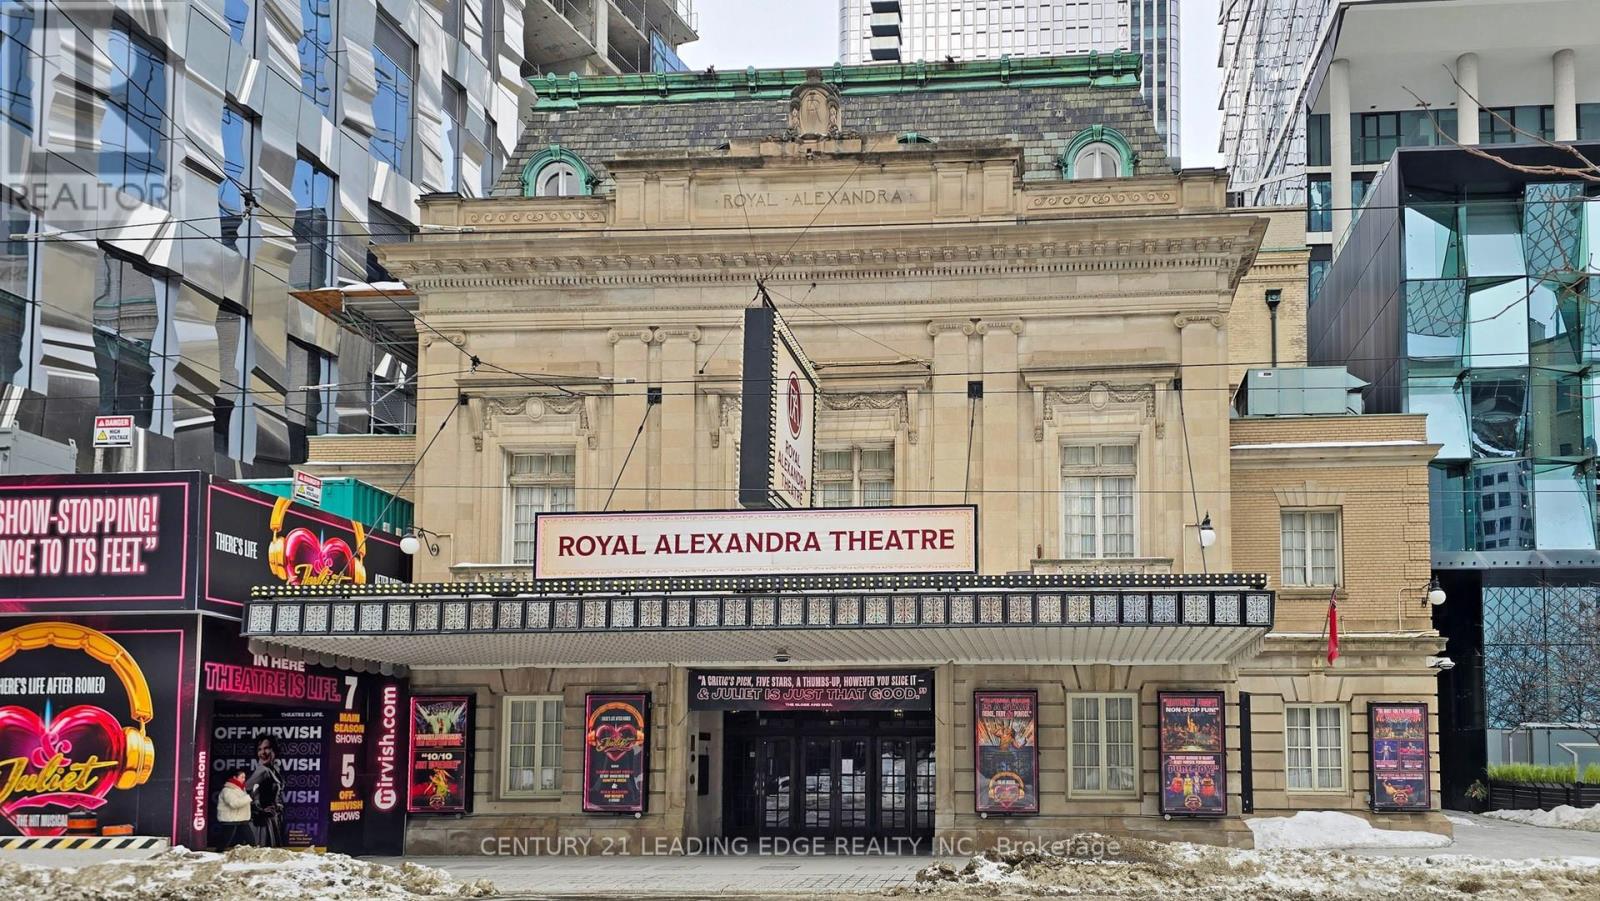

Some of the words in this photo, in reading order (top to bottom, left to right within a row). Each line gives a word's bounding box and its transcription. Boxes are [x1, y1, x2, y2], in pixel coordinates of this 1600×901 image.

[724, 193, 778, 208] ROYAL
[792, 189, 903, 207] ALEXANDRA
[785, 440, 801, 468] ROYAL
[777, 450, 807, 490] ALEXANDRA
[781, 472, 803, 506] THEATRE
[40, 539, 62, 574] TO
[68, 538, 97, 573] ITS
[215, 532, 244, 557] THERE'S
[244, 541, 258, 559] LIFE
[558, 535, 646, 557] ROYAL
[653, 531, 821, 554] ALEXANDRA
[829, 529, 955, 551] THEATRE
[253, 655, 269, 667] IN
[271, 658, 306, 672] HERE
[28, 677, 46, 695] LIFE
[46, 677, 73, 694] AFTER
[75, 676, 105, 694] ROMEO
[204, 662, 287, 697] THEATRE
[287, 672, 306, 698] IS
[307, 675, 342, 702] LIFE.
[345, 676, 358, 709] 7
[697, 687, 709, 700] &
[711, 687, 762, 700] JULIET
[764, 688, 781, 700] IS
[783, 688, 824, 700] JUST
[827, 688, 867, 700] THAT
[708, 675, 735, 687] CRITIC'S
[736, 676, 754, 688] PICK,
[756, 676, 770, 687] FIVE
[771, 676, 794, 689] STARS,
[844, 676, 875, 687] HOWEVER
[877, 676, 890, 687] YOU
[891, 675, 909, 686] SLICE
[910, 675, 917, 686] IT
[334, 723, 365, 734] SEASON
[335, 734, 363, 744] SHOWS
[341, 754, 355, 788] 5
[332, 811, 360, 822] SHOWS
